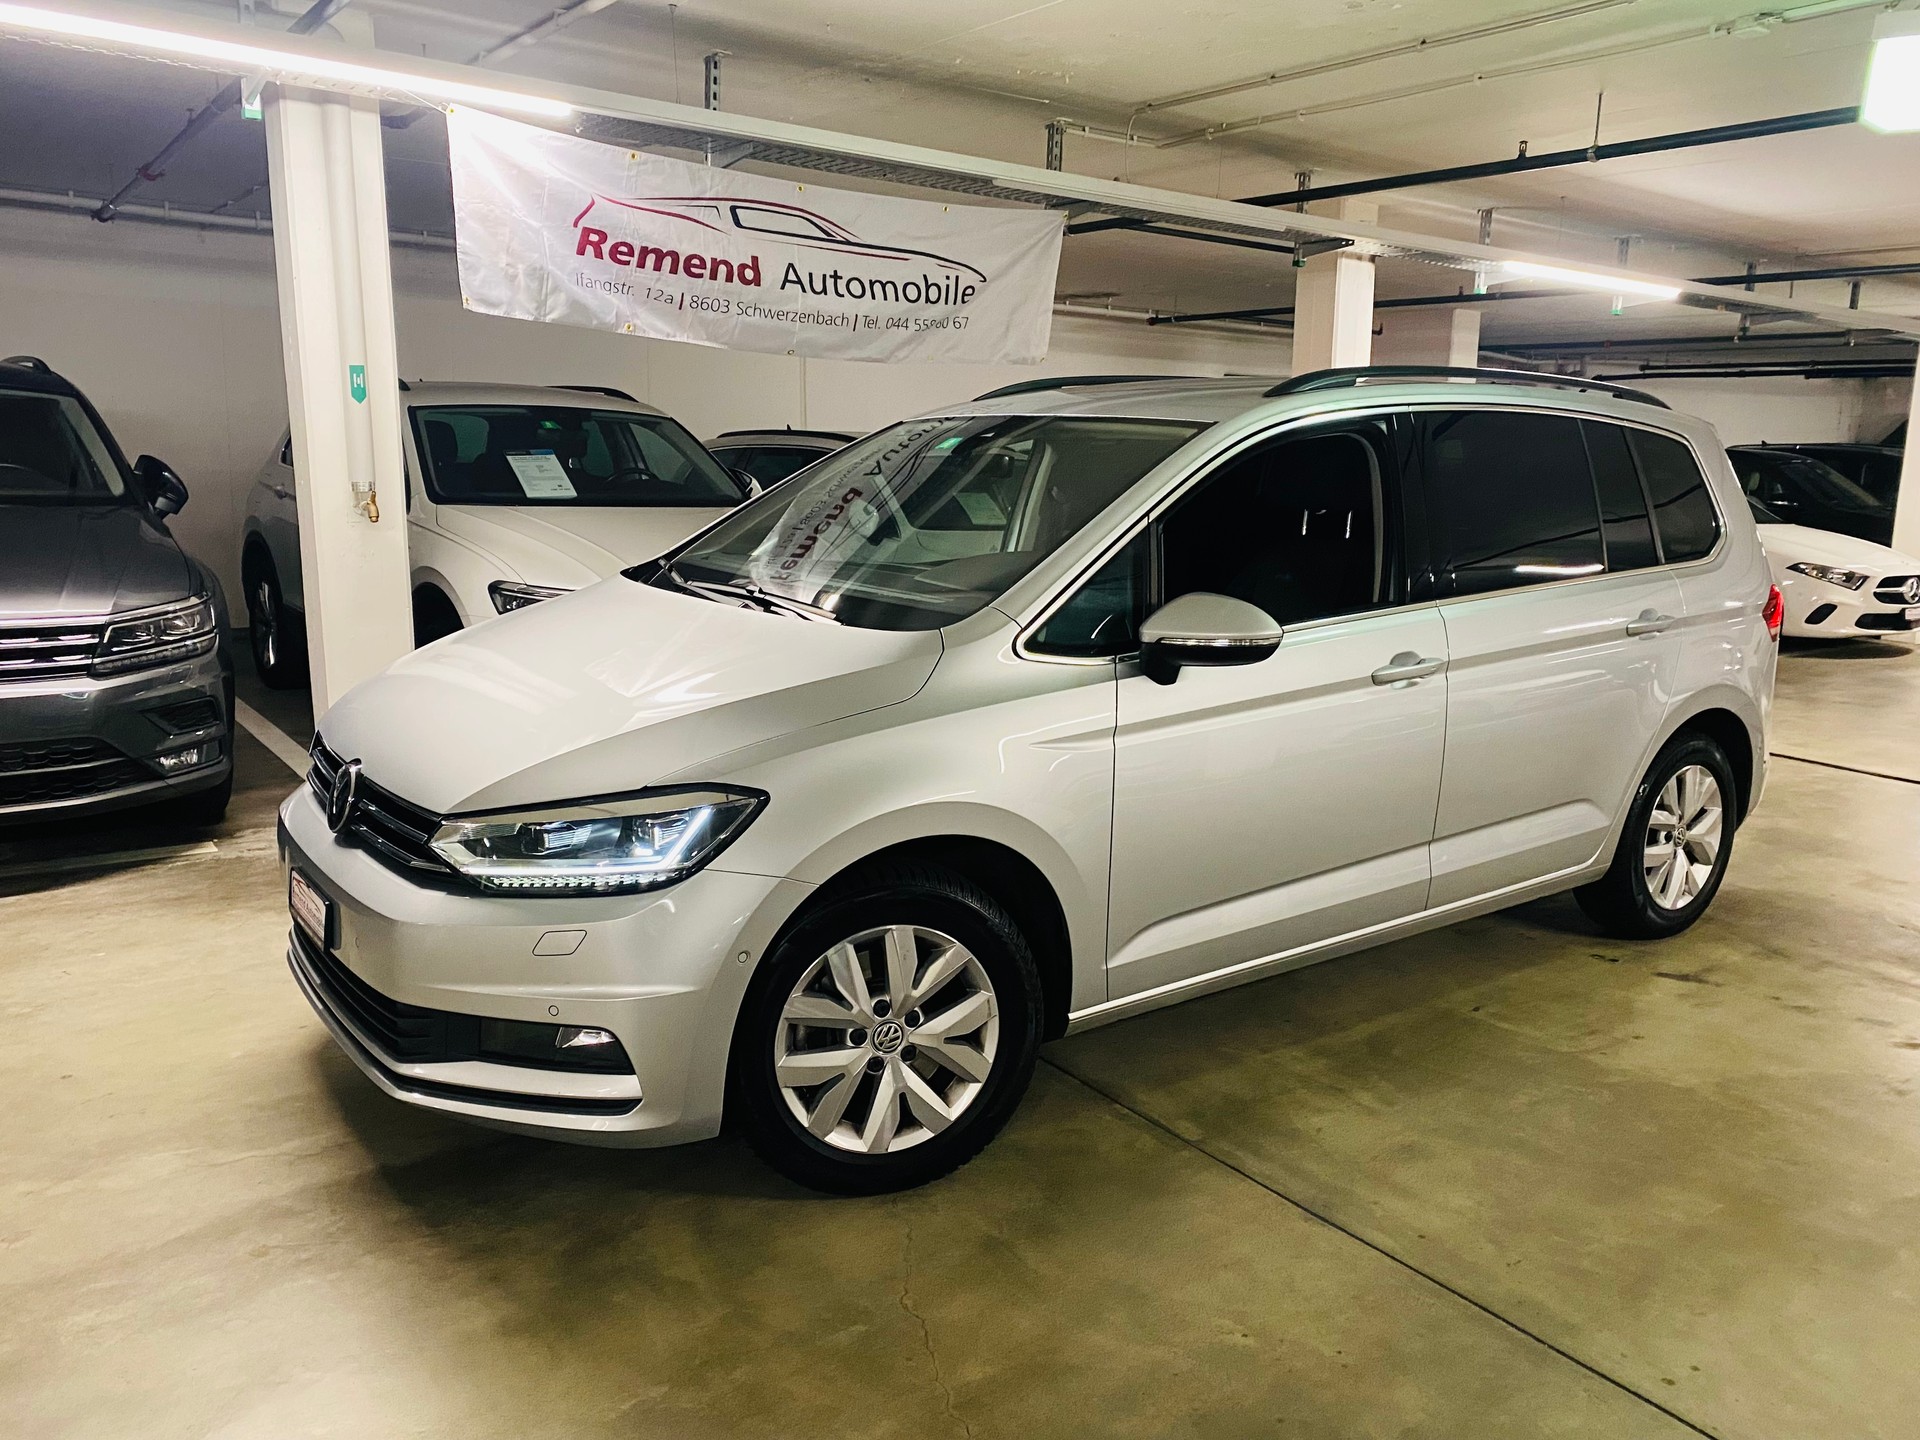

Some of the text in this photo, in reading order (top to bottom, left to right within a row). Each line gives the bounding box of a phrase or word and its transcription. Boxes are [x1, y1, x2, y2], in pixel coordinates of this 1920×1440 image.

[575, 226, 976, 306] Remend Automobile
[645, 287, 674, 305] 12a
[689, 295, 731, 314] 8603
[735, 301, 850, 328] Schwerzenbach
[862, 315, 881, 330] Tel.
[885, 316, 909, 331] 044
[952, 316, 969, 330] 67
